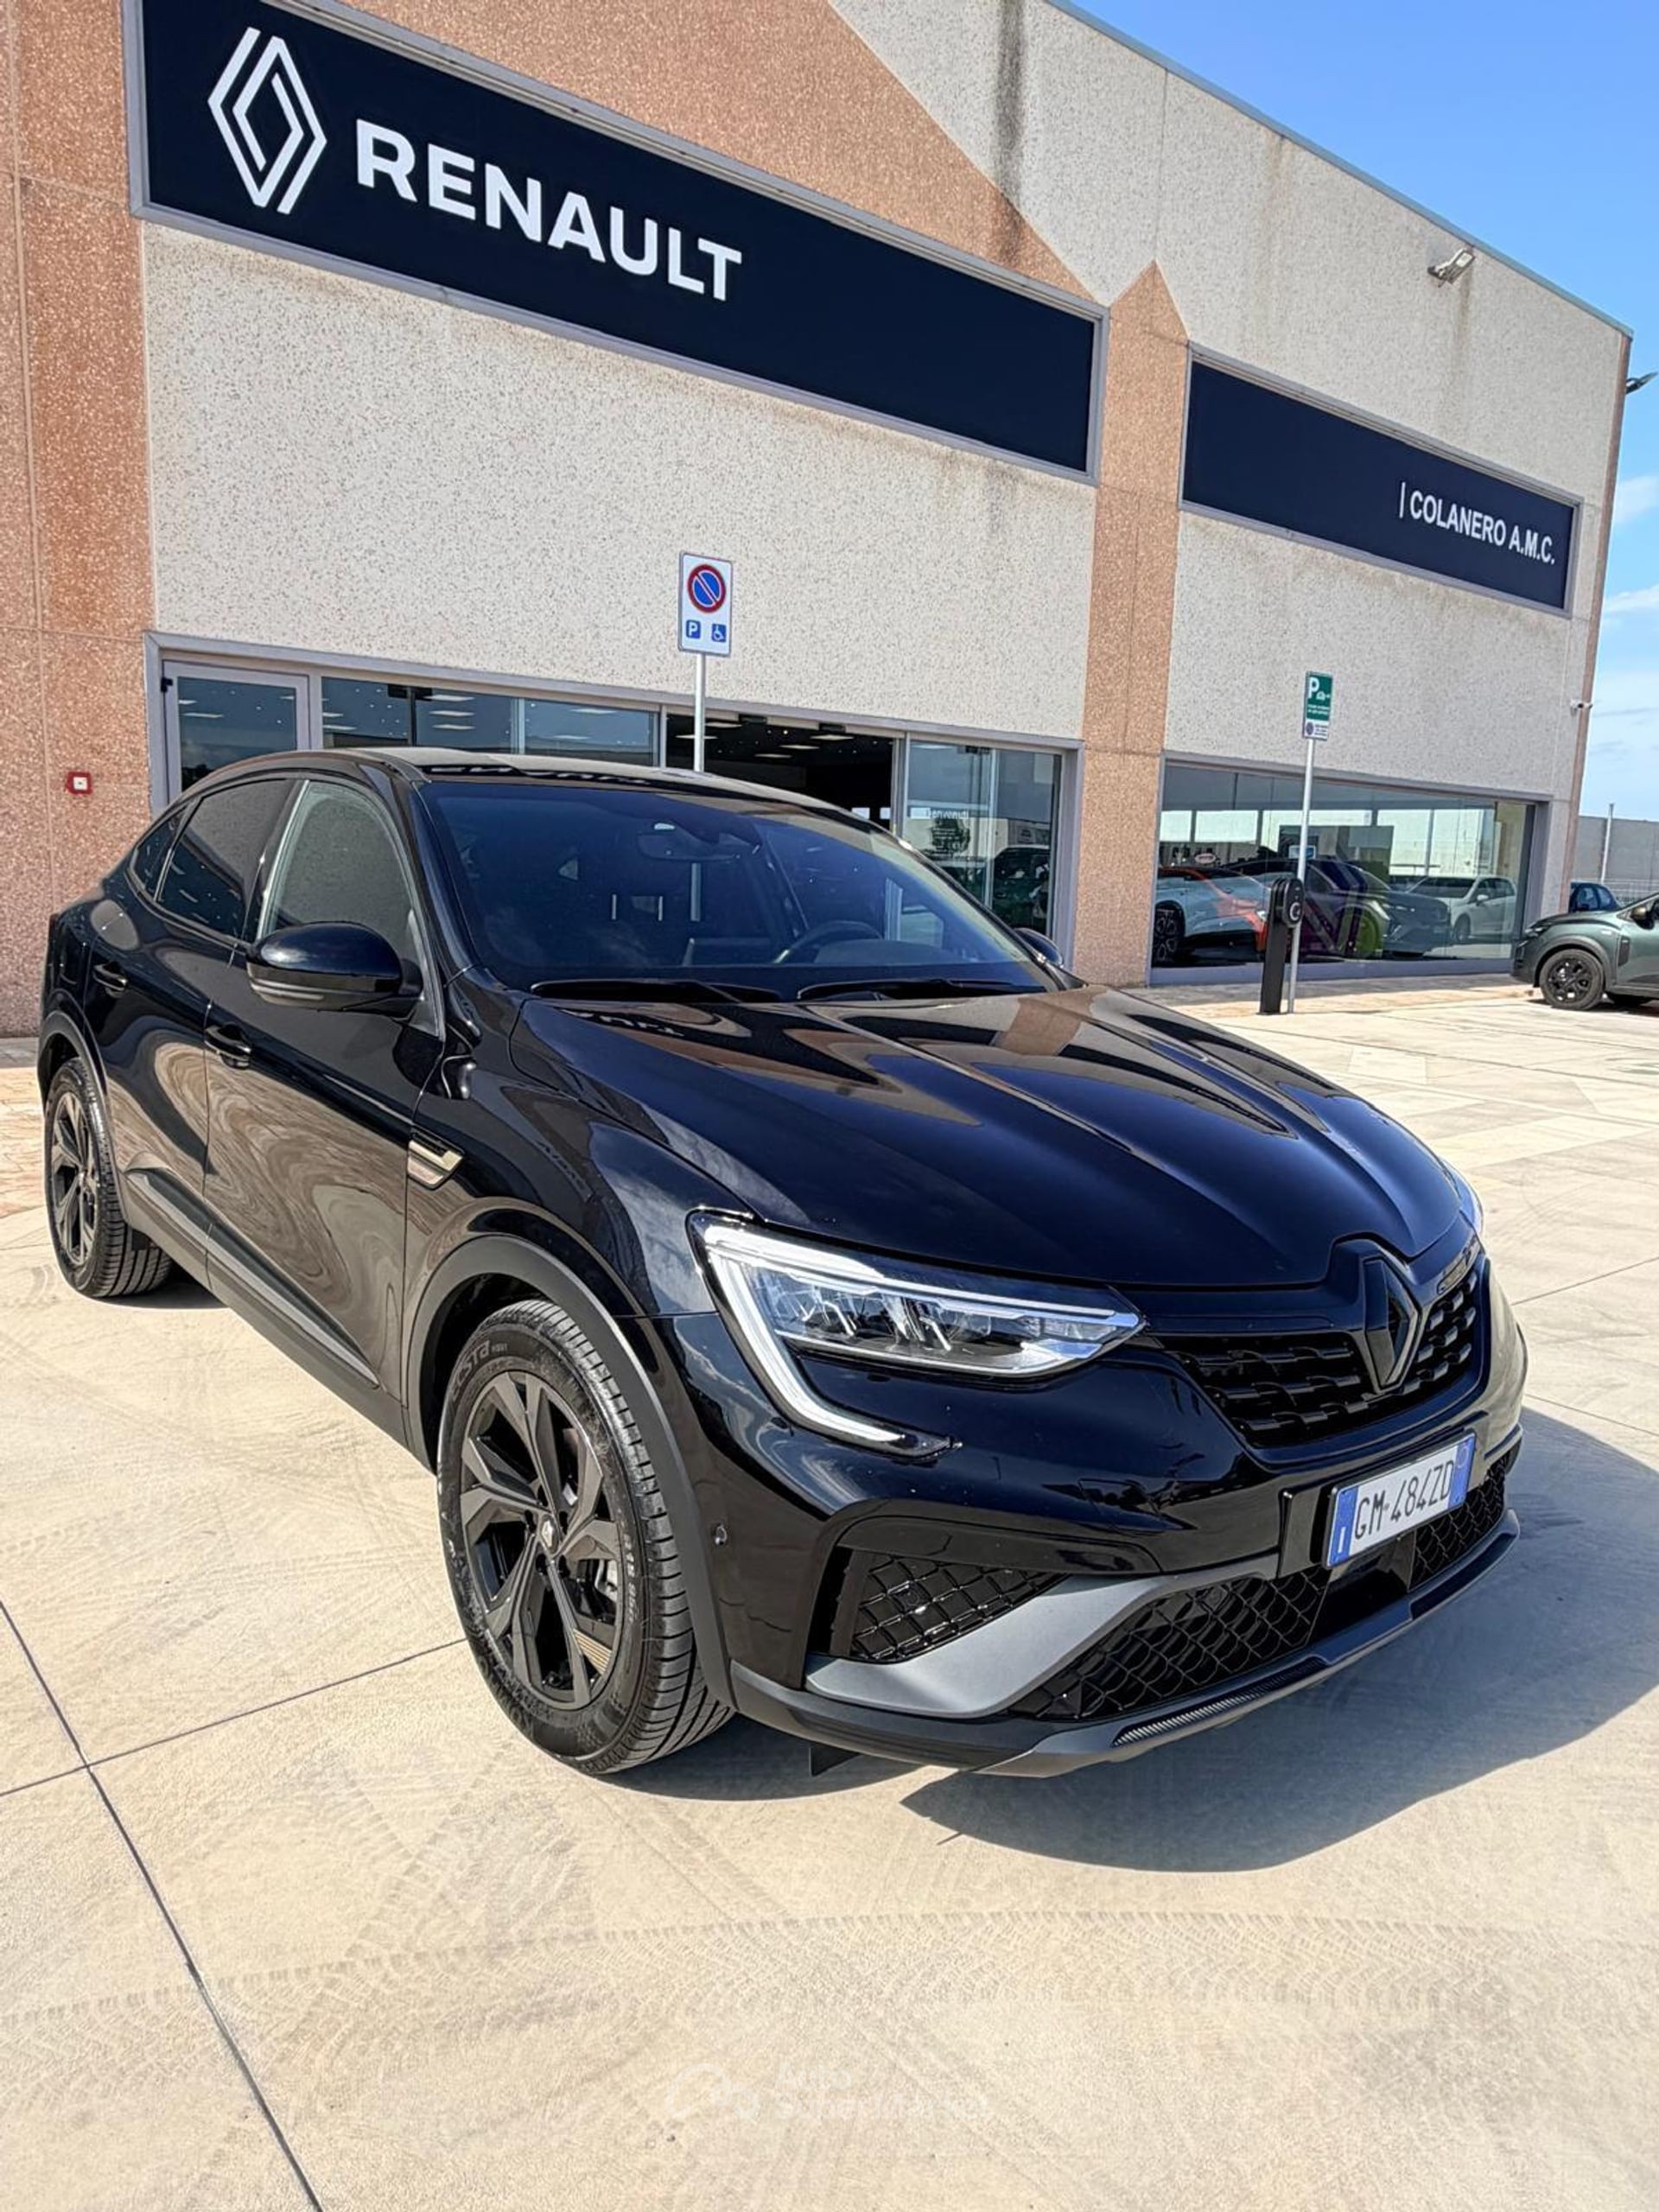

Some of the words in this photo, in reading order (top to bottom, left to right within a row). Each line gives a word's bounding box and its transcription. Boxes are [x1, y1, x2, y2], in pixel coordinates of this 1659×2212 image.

[356, 118, 742, 302] RENAULT
[1409, 490, 1507, 547] COLANERO
[1508, 524, 1555, 565] A.M.C.
[1308, 677, 1320, 699] P
